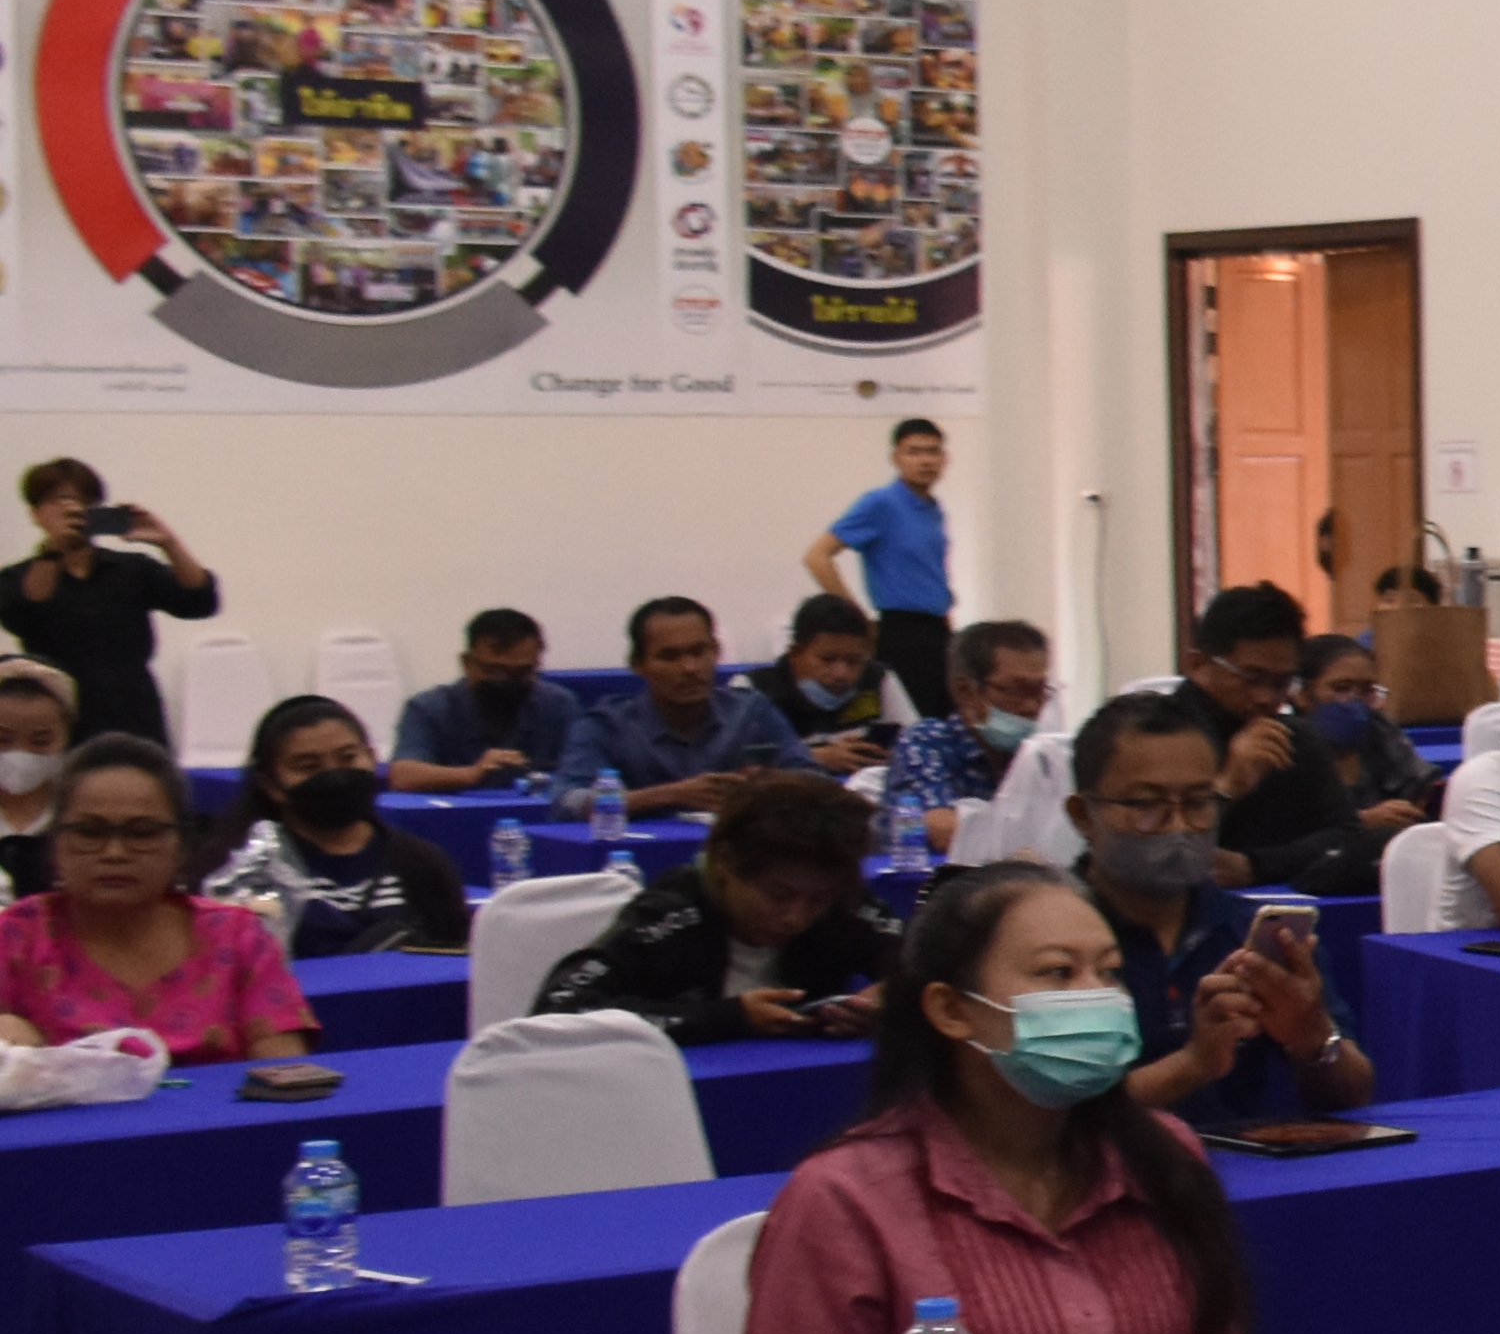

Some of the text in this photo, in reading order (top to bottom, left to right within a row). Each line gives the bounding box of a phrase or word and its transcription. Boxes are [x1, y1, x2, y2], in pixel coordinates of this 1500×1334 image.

[530, 371, 735, 398] Change for Good
